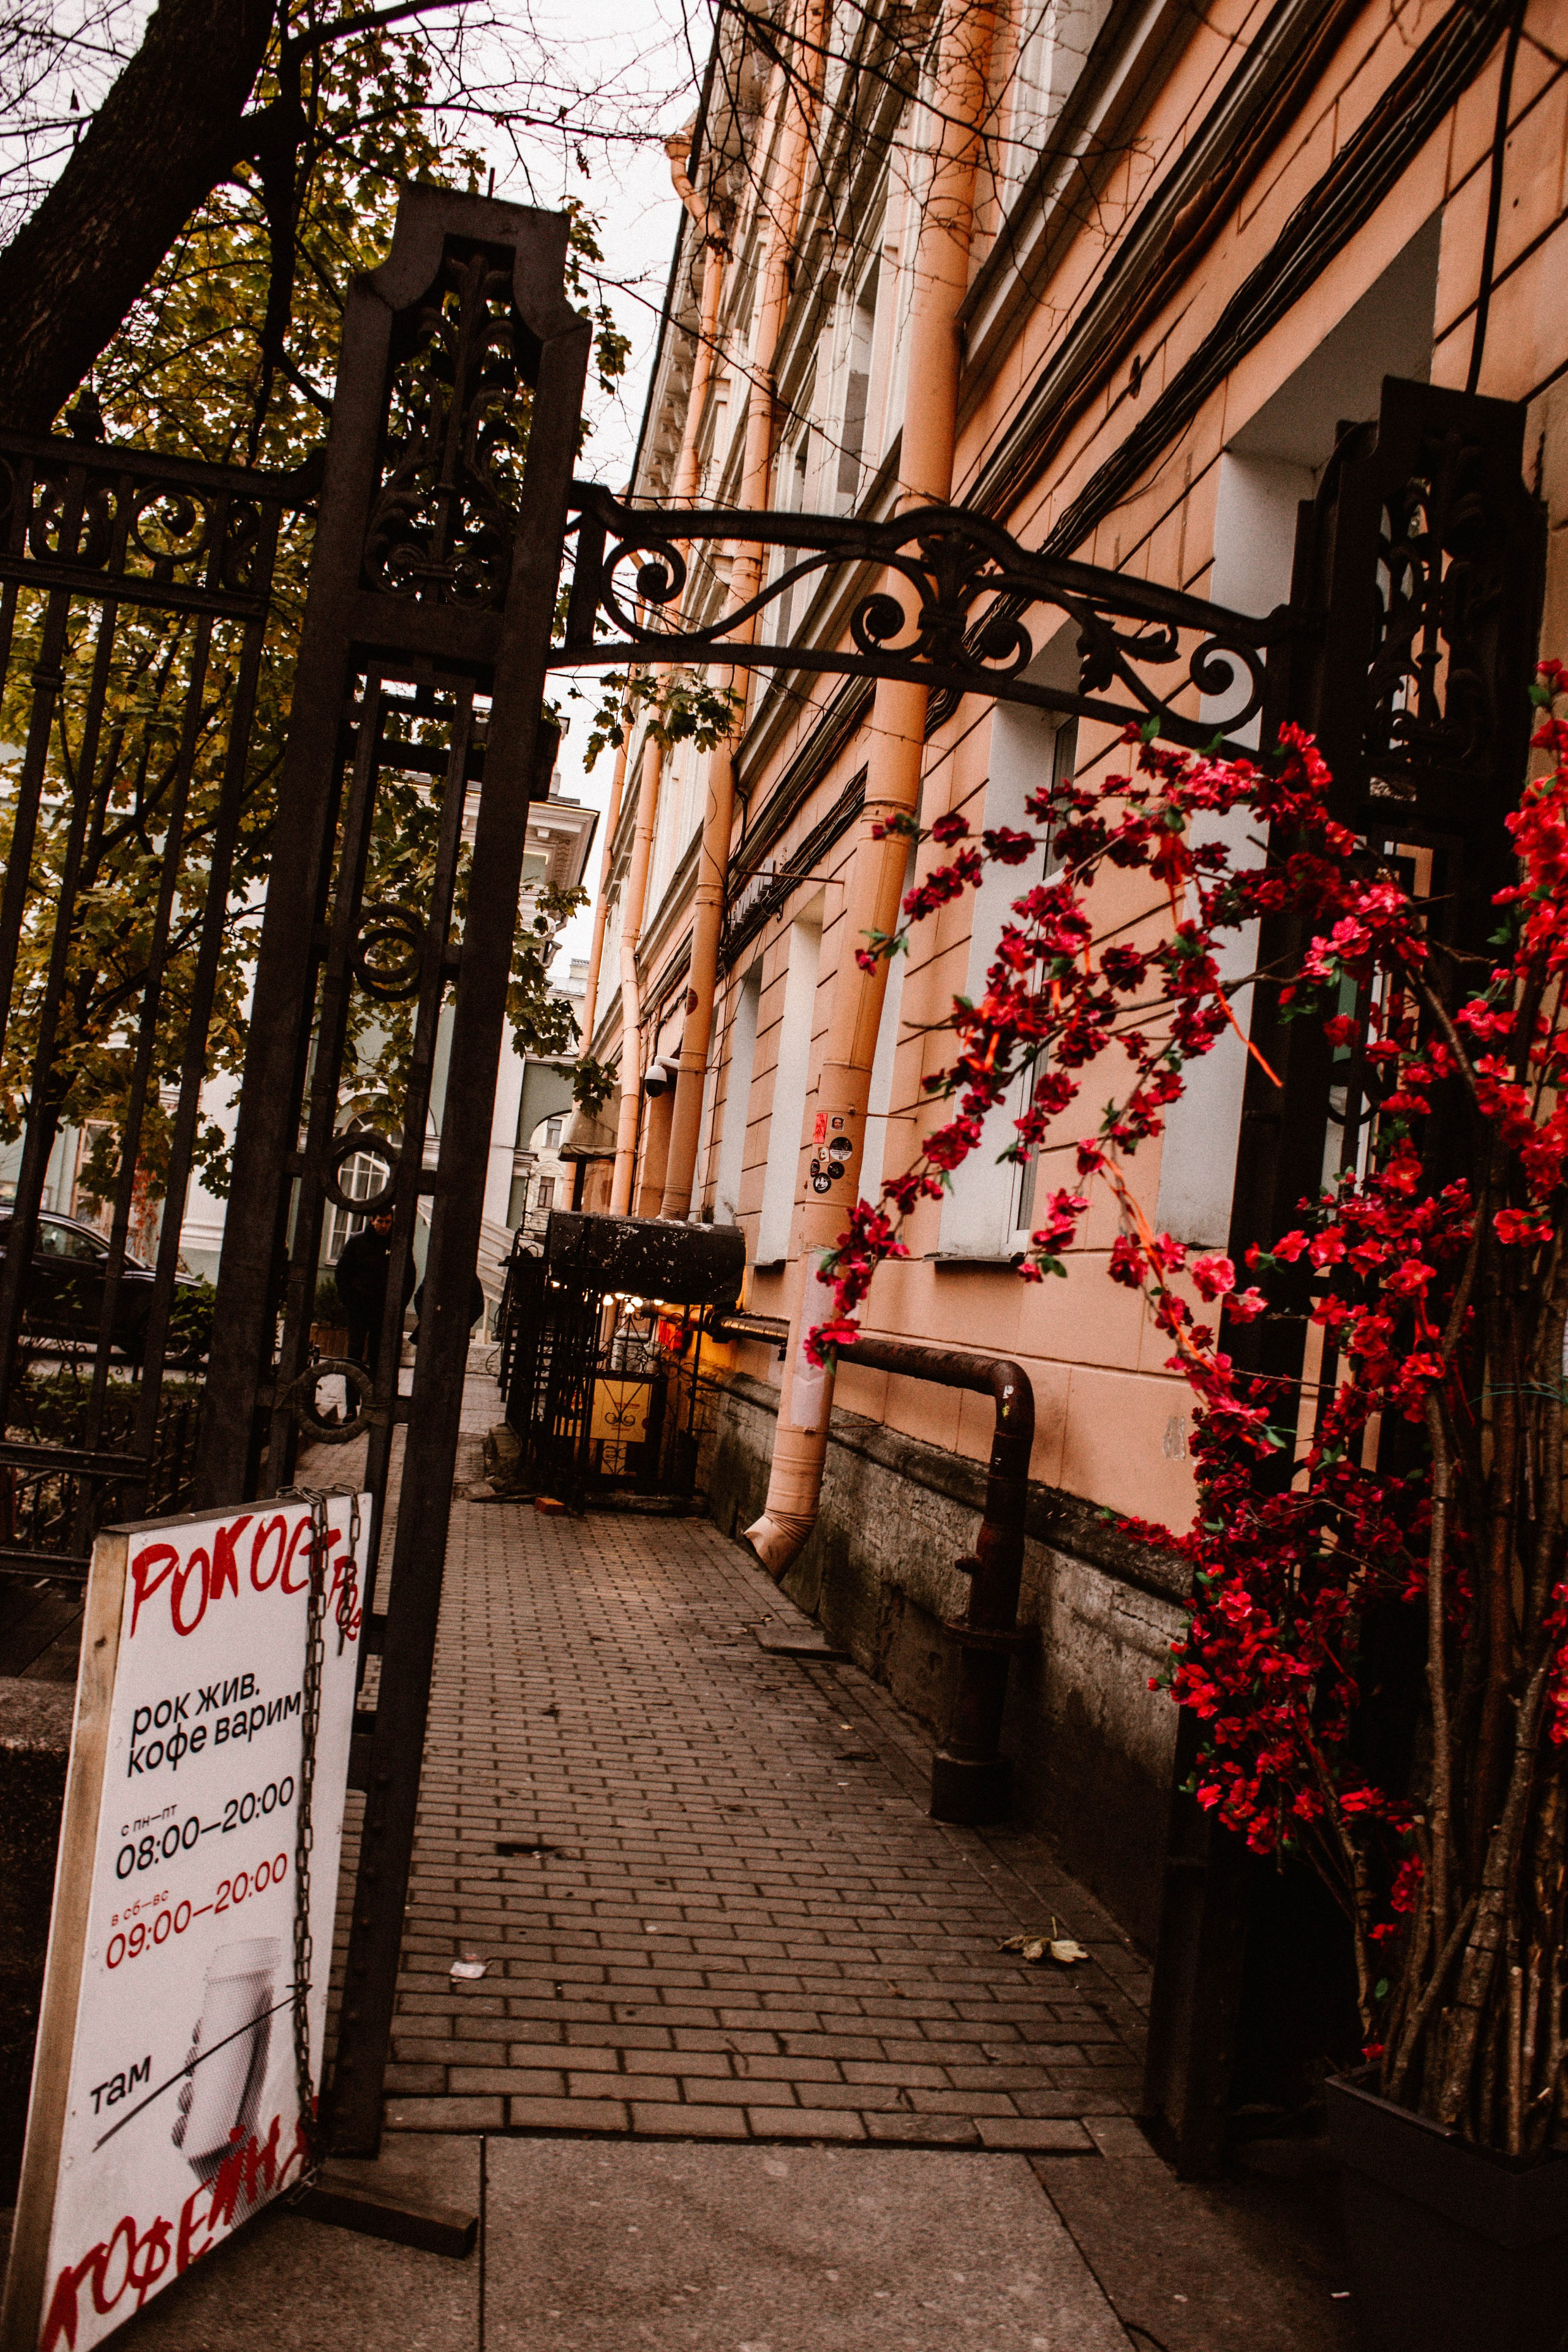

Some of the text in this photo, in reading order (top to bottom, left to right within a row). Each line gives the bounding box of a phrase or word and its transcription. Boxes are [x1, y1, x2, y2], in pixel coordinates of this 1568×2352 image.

[127, 1691, 302, 1777] кофе варим
[130, 1673, 260, 1748] рок жив.
[89, 2054, 152, 2115] там
